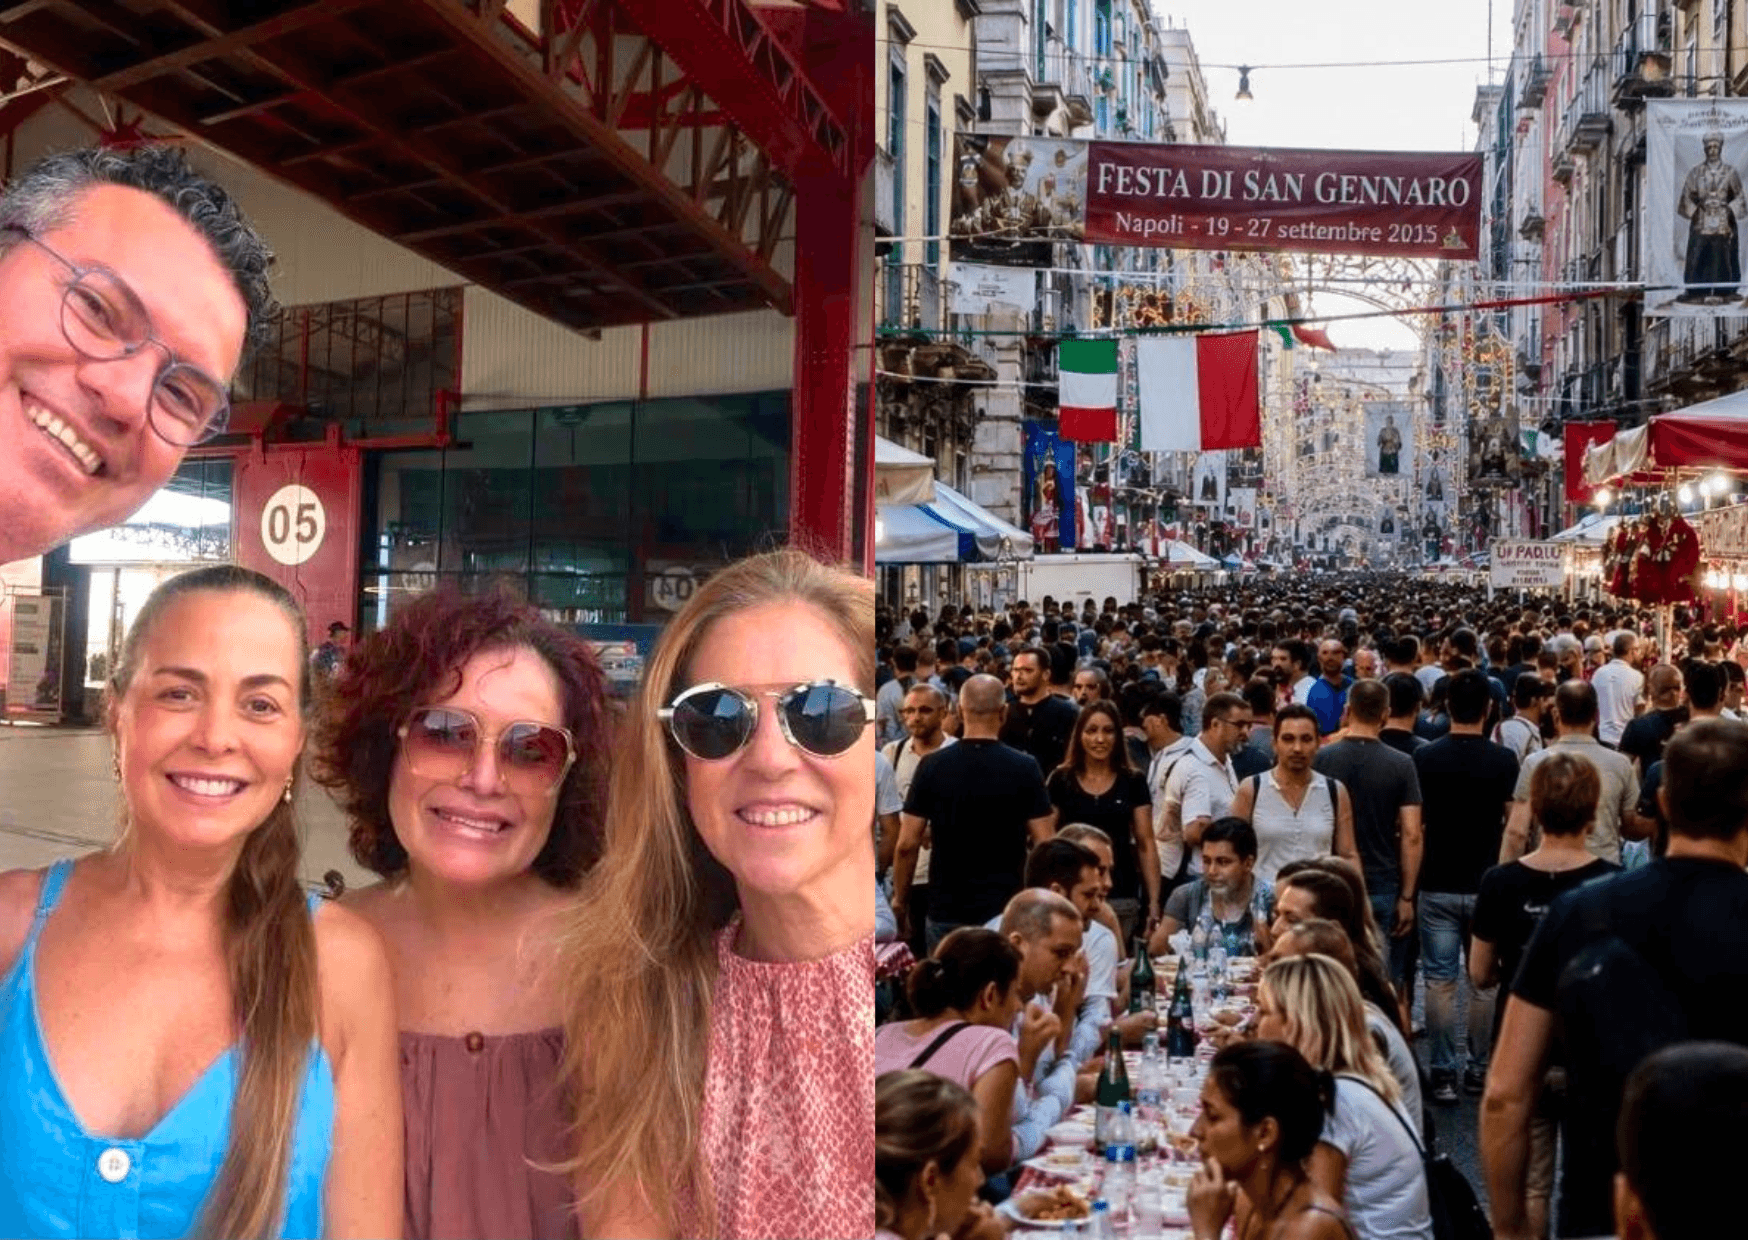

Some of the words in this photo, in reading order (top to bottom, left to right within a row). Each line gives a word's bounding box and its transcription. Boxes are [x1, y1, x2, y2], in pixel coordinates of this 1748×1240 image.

[1097, 162, 1191, 198] FESTA
[1200, 169, 1234, 200] DI
[1243, 169, 1305, 201] SAN
[1314, 171, 1470, 207] GENNARO
[1116, 211, 1184, 238] Napoli
[1205, 216, 1230, 236] 19
[1247, 218, 1272, 237] 27
[1277, 221, 1383, 242] settembre
[1387, 223, 1439, 244] 2015
[268, 502, 318, 545] 05
